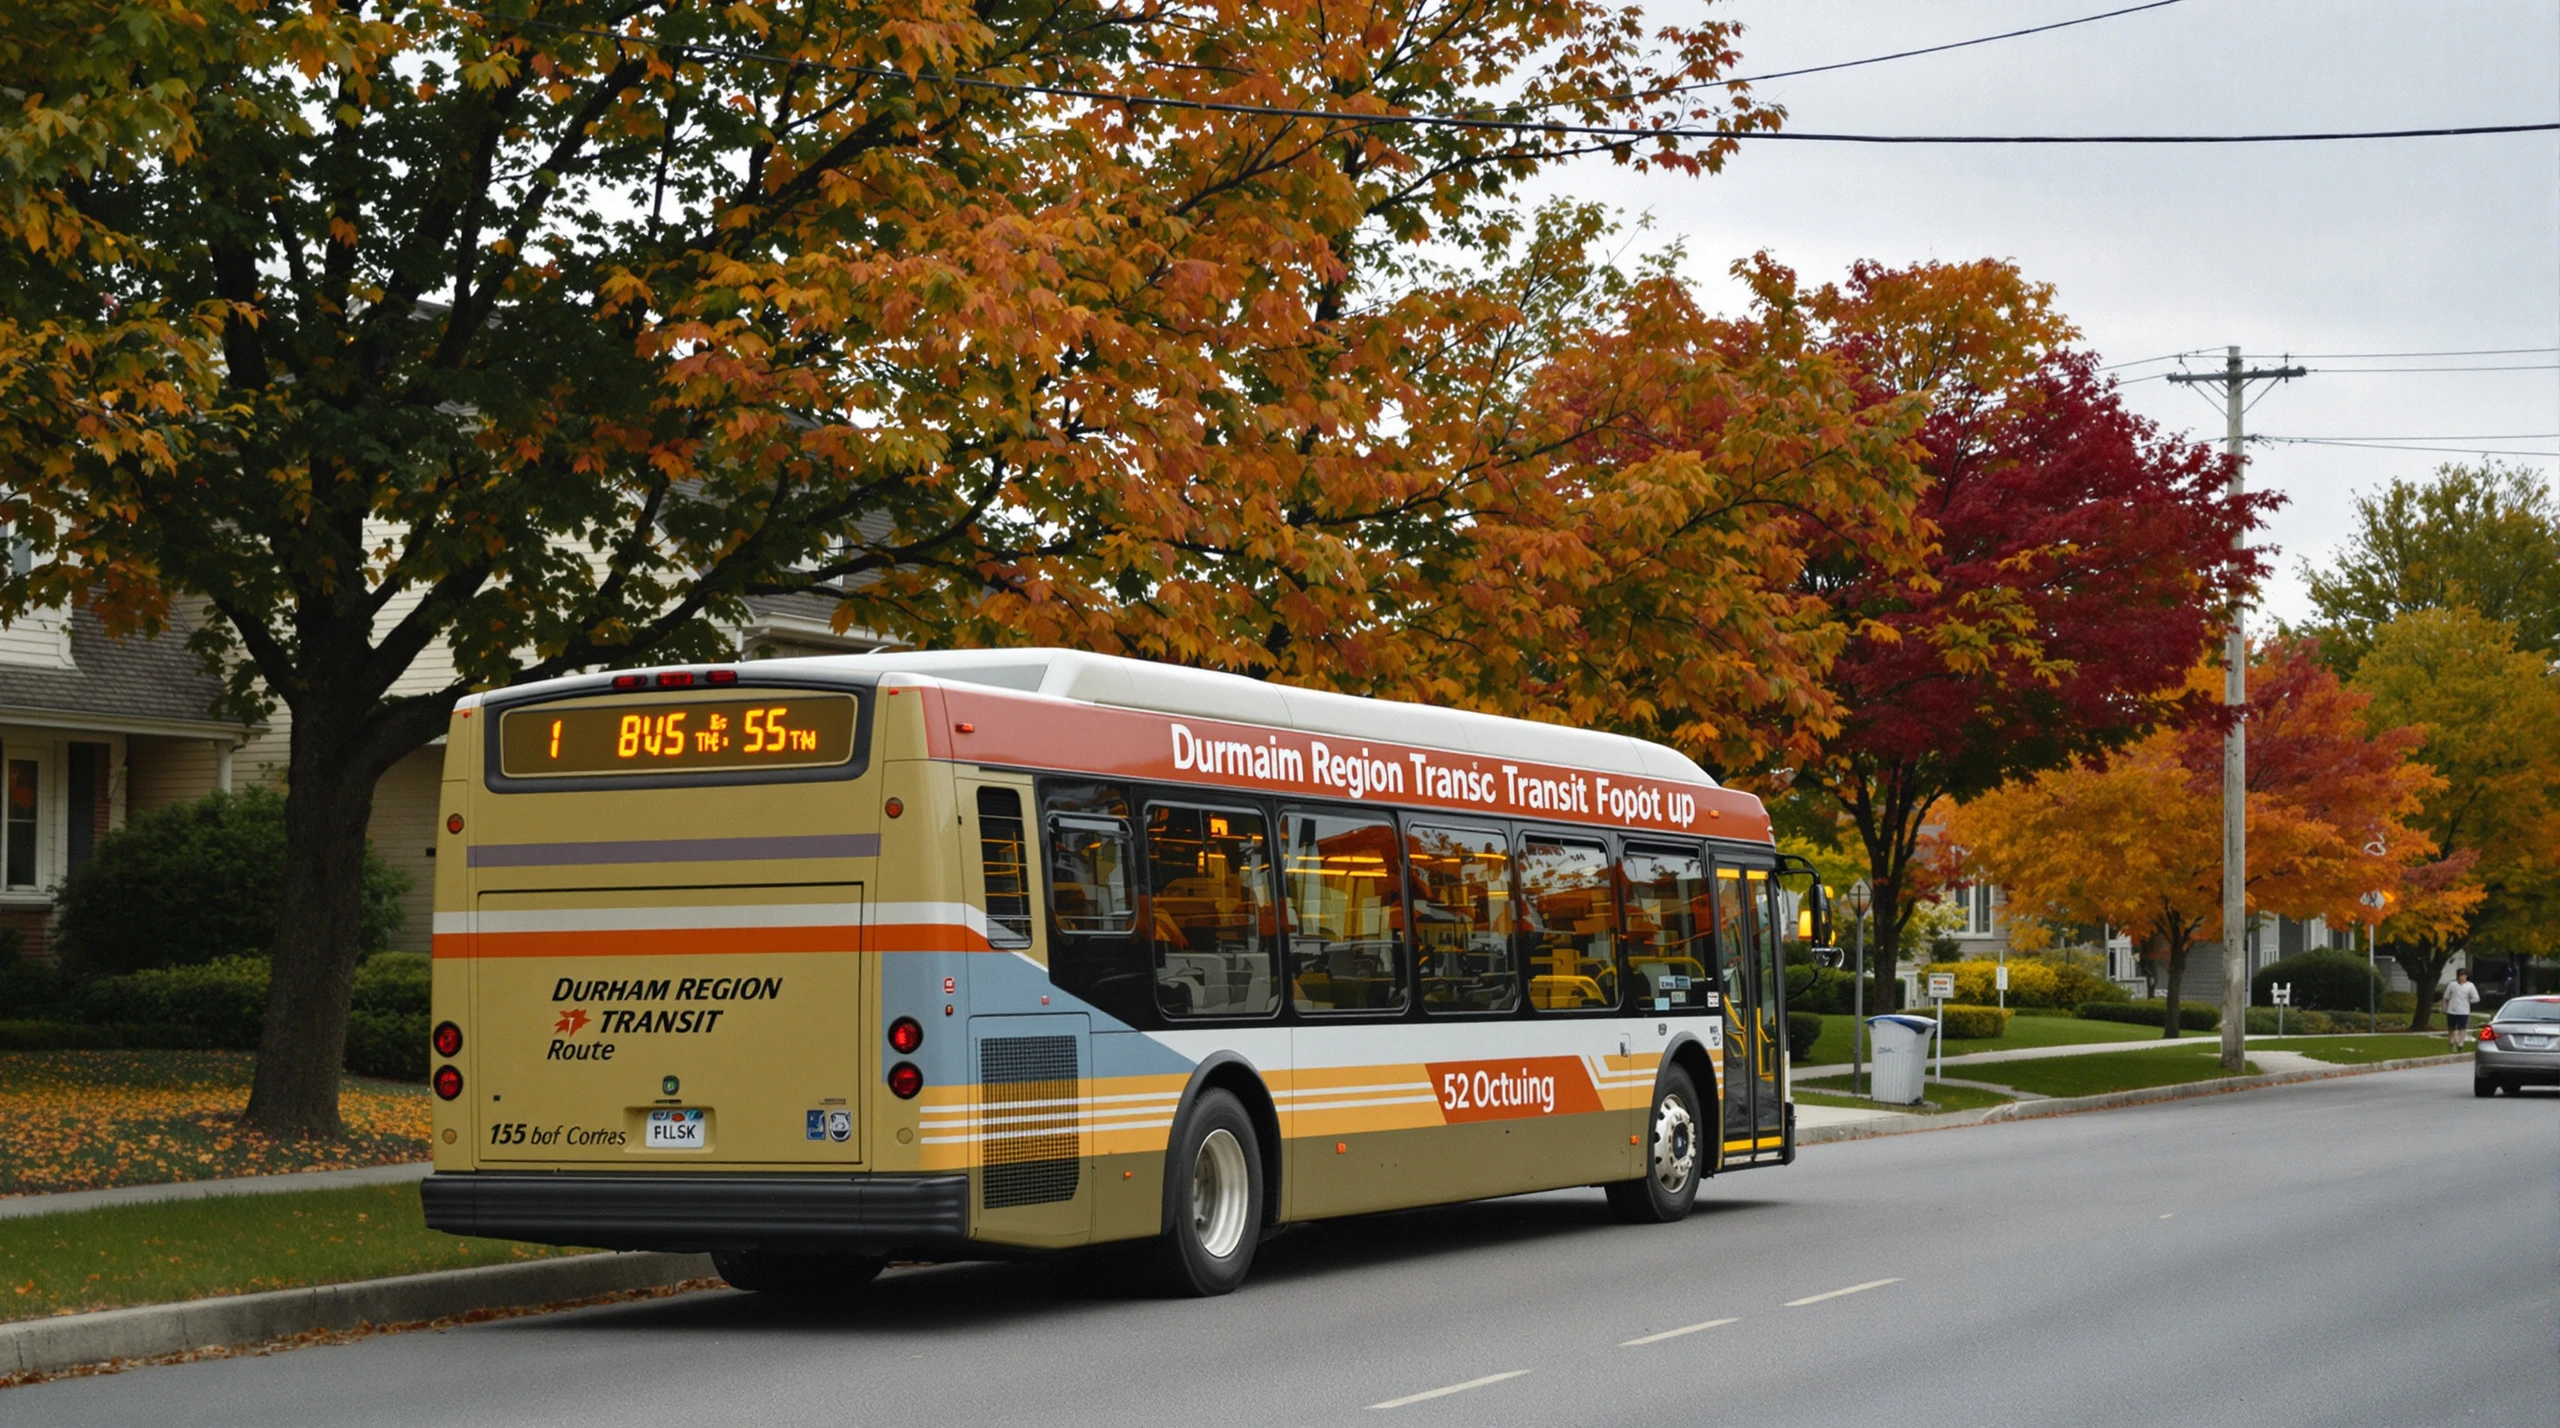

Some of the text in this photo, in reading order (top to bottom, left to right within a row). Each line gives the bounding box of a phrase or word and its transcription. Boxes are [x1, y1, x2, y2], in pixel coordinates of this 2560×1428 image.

[1171, 724, 1303, 782] Durmaim
[1311, 742, 1402, 798] Region
[1502, 766, 1587, 811] Transit
[1668, 792, 1695, 828] up
[552, 977, 782, 1001] DURHAM REGION
[600, 1010, 723, 1033] TRANSIT
[547, 1039, 615, 1060] Route
[1444, 1068, 1555, 1112] 52 Octuing
[491, 1124, 527, 1144] 155
[531, 1125, 563, 1145] bof
